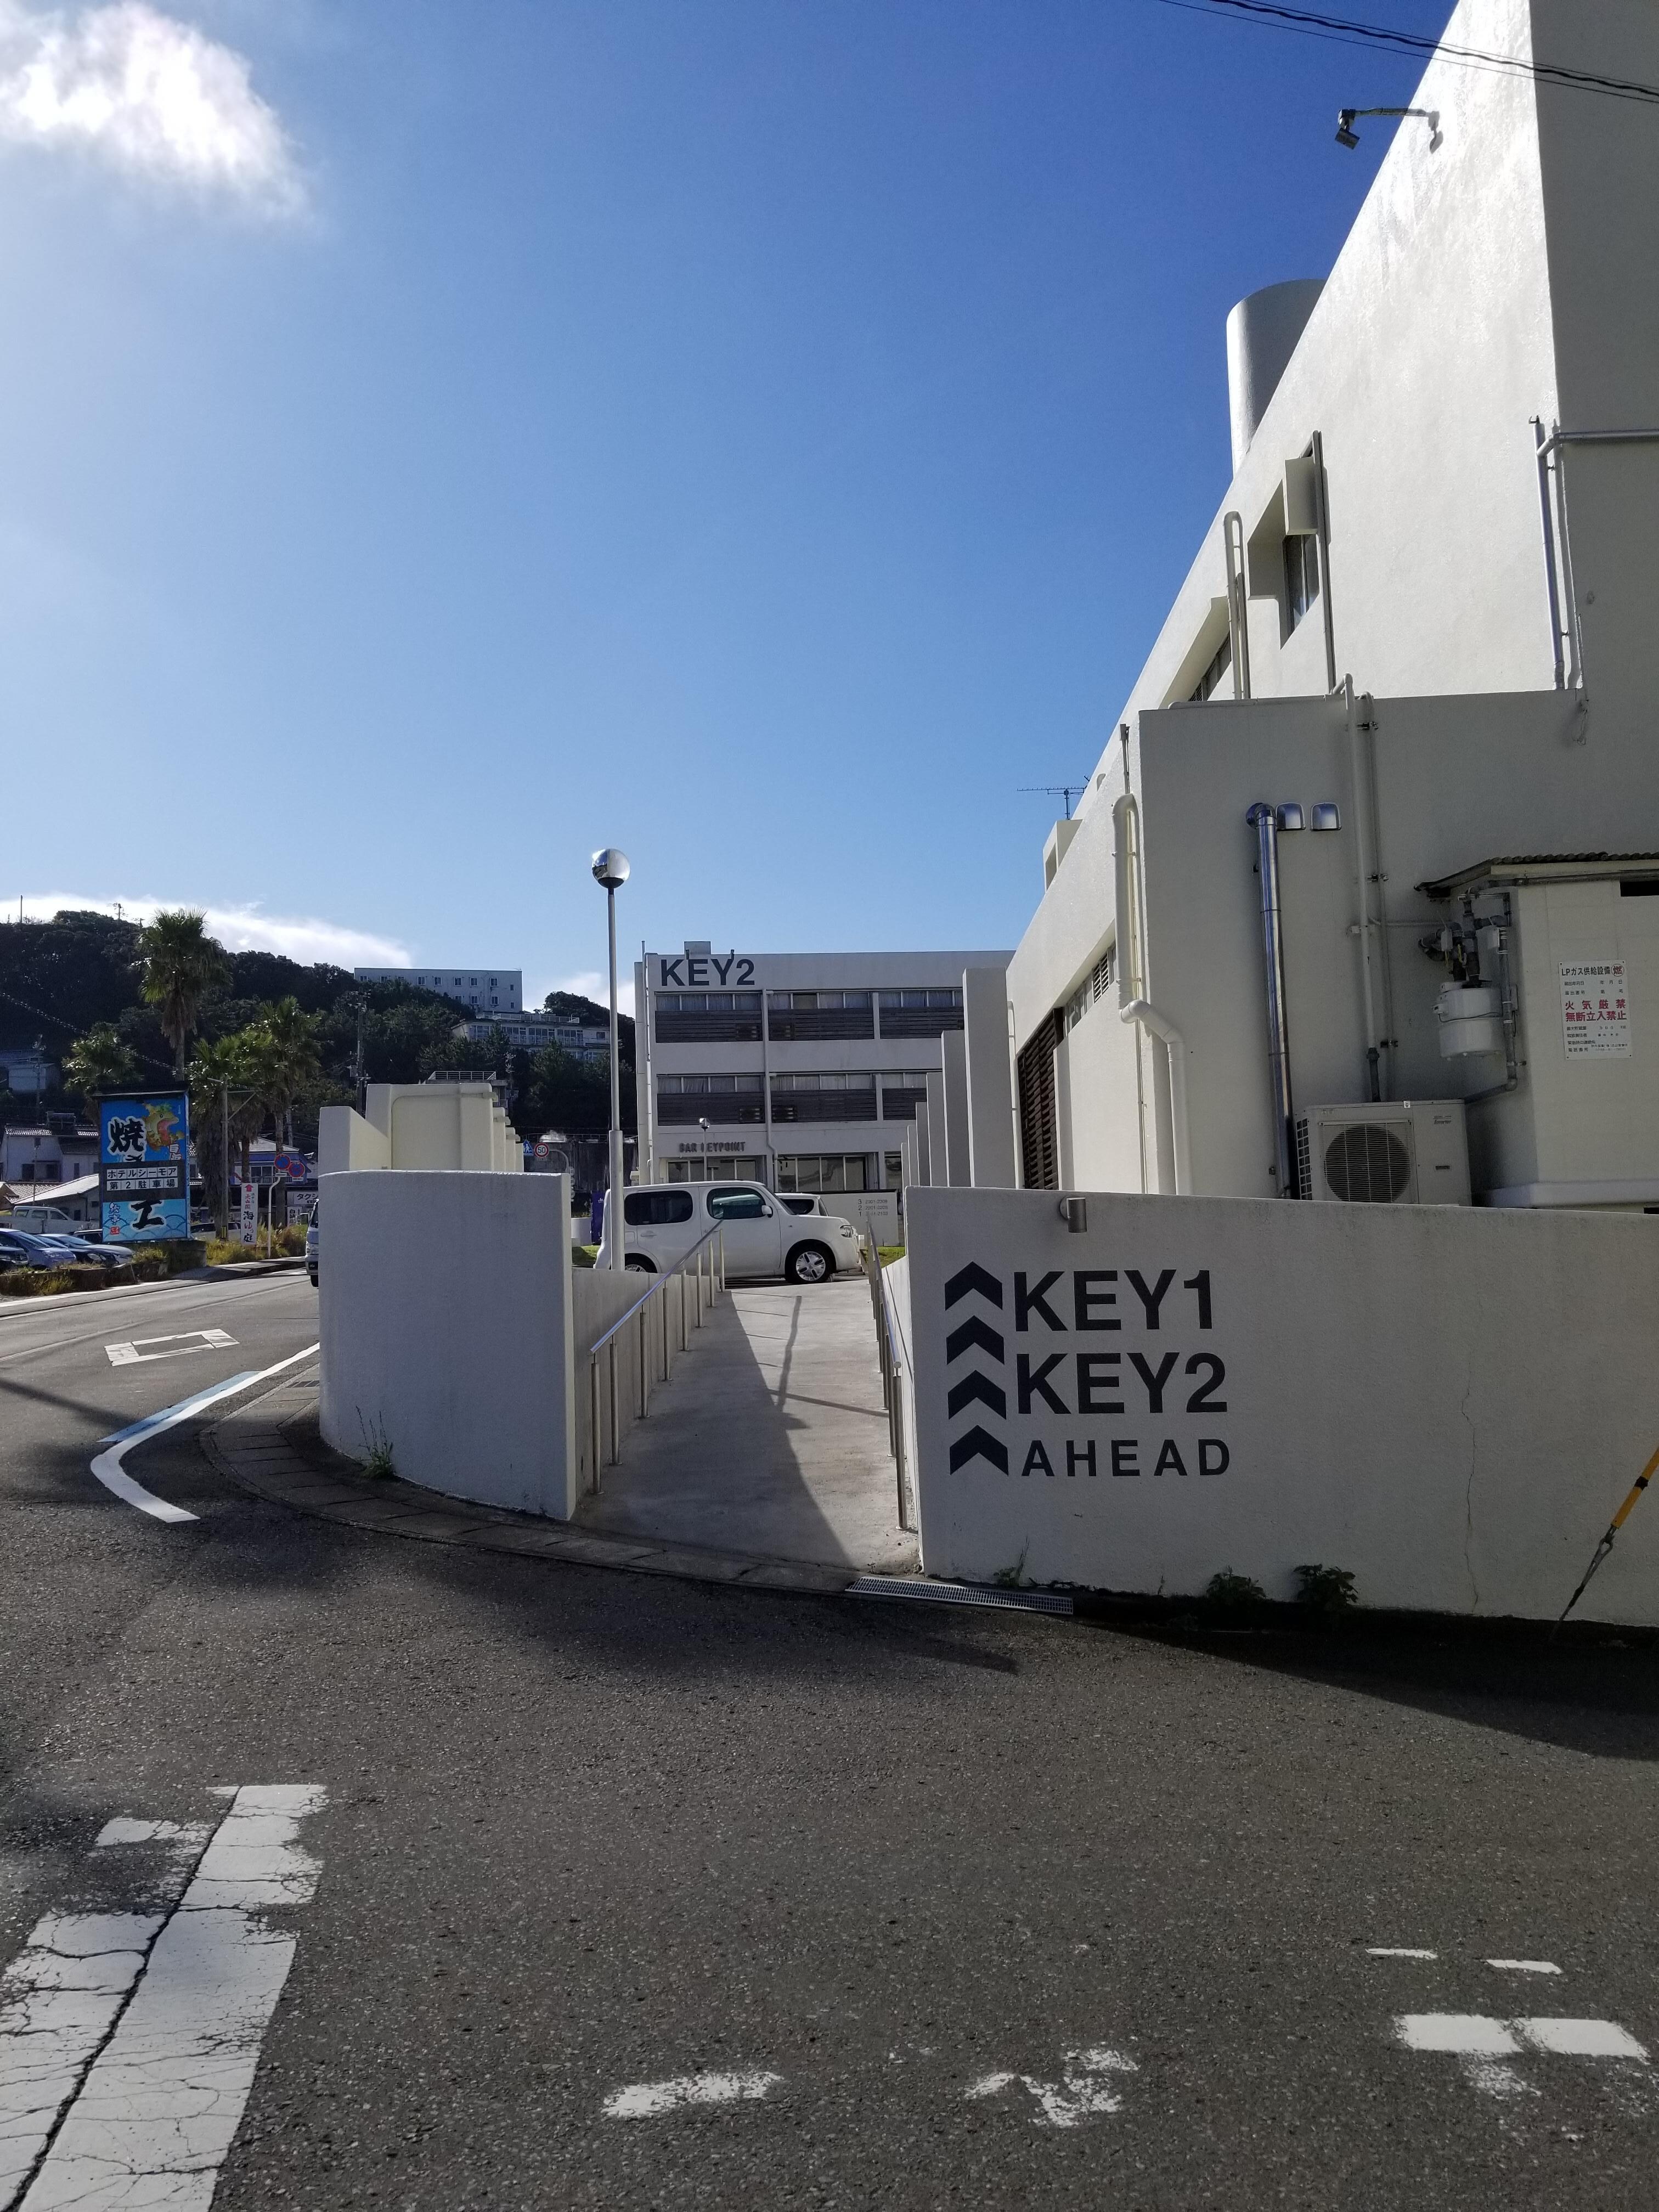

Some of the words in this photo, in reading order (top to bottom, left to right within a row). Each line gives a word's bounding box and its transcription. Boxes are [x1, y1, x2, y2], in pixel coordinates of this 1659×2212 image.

[661, 958, 755, 986] KEY2
[1565, 998, 1626, 1010] 火気厳禁
[1565, 1010, 1627, 1022] 無断立入禁止
[108, 1168, 177, 1178] ホテルシーモア
[110, 1178, 175, 1190] 第2駐車場
[1013, 1269, 1212, 1332] KEY1
[1016, 1352, 1228, 1414] KEY2
[1021, 1438, 1230, 1477] AHEAD
